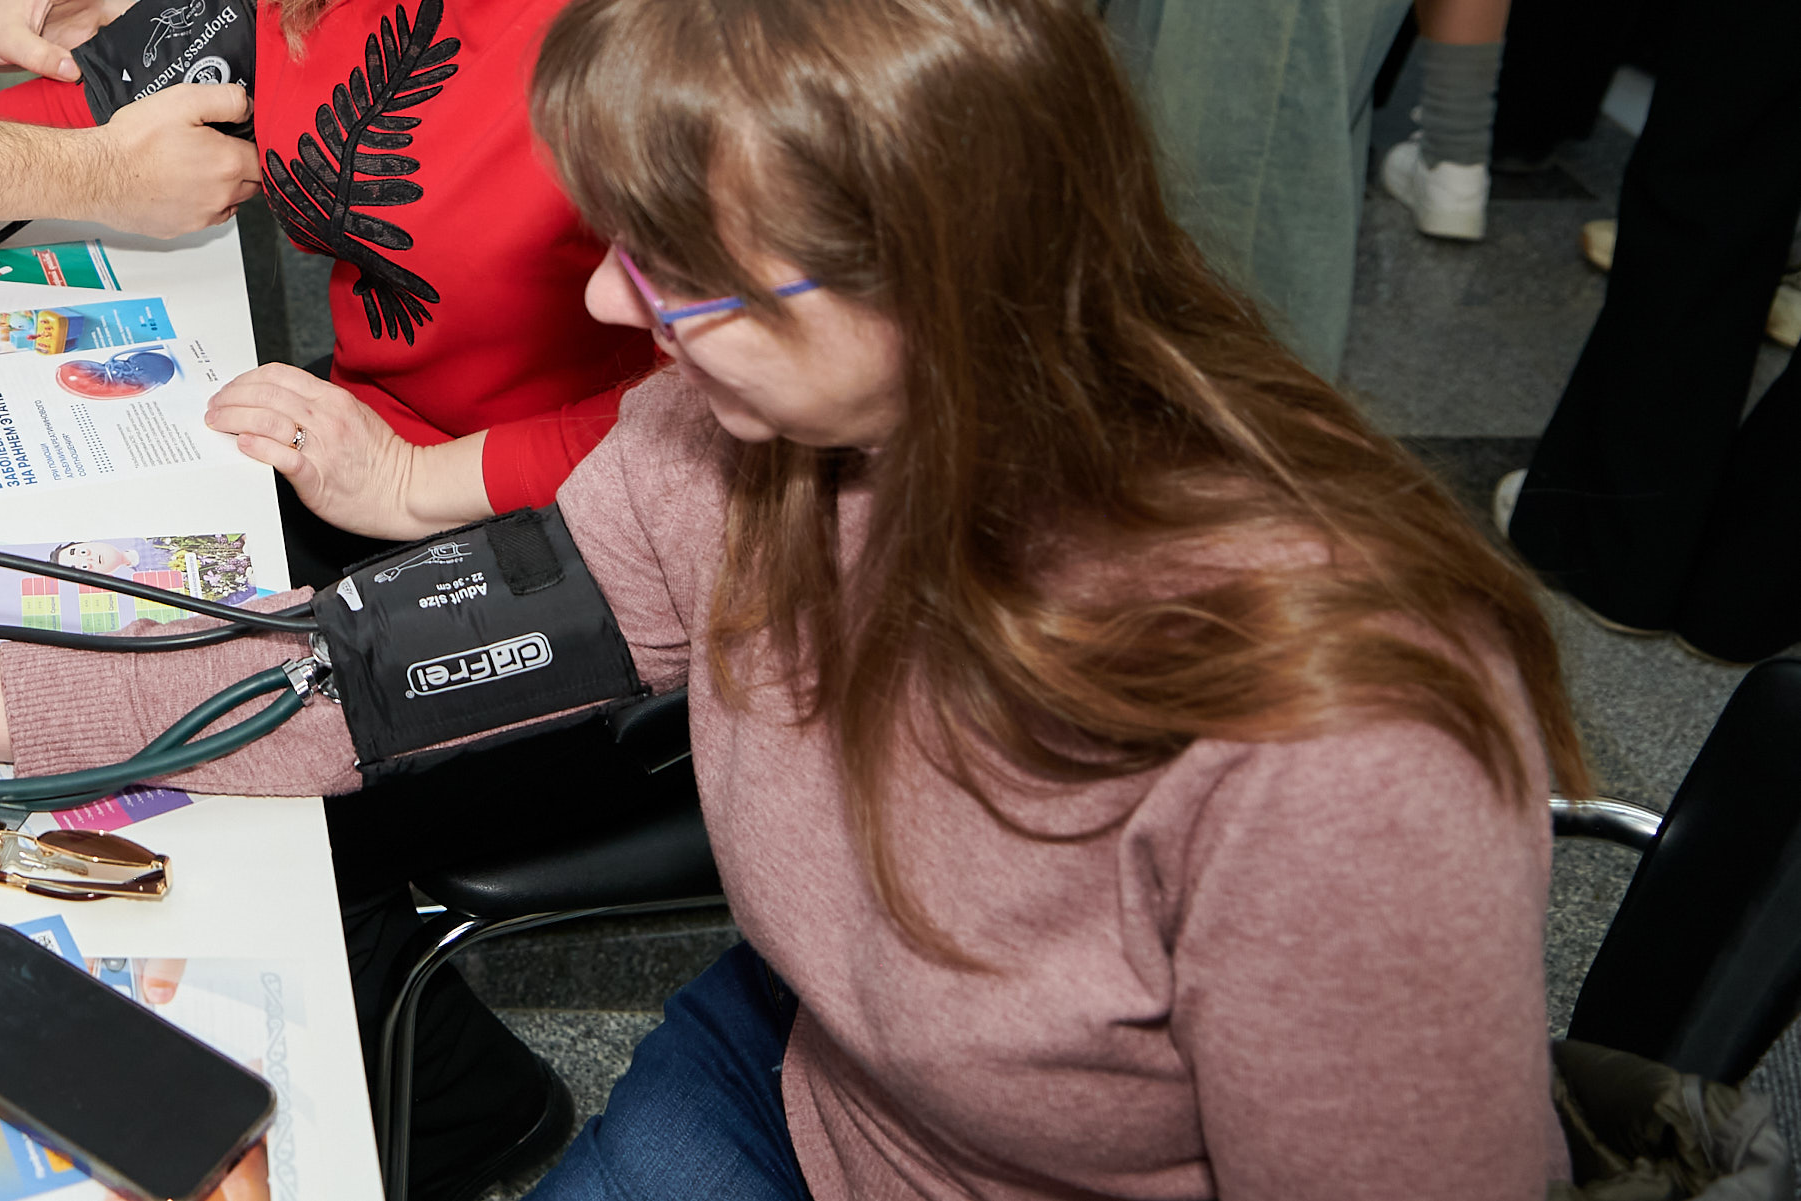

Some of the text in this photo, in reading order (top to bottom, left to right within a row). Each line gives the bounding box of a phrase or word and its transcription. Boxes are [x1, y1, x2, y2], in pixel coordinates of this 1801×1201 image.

[2, 425, 31, 468] РАННЕМ
[41, 442, 62, 481] ПРИ ПОМОЩИ
[19, 468, 38, 485] НА
[452, 577, 465, 589] 36
[470, 572, 485, 583] 22
[418, 582, 488, 609] Adult size
[435, 583, 452, 591] cm
